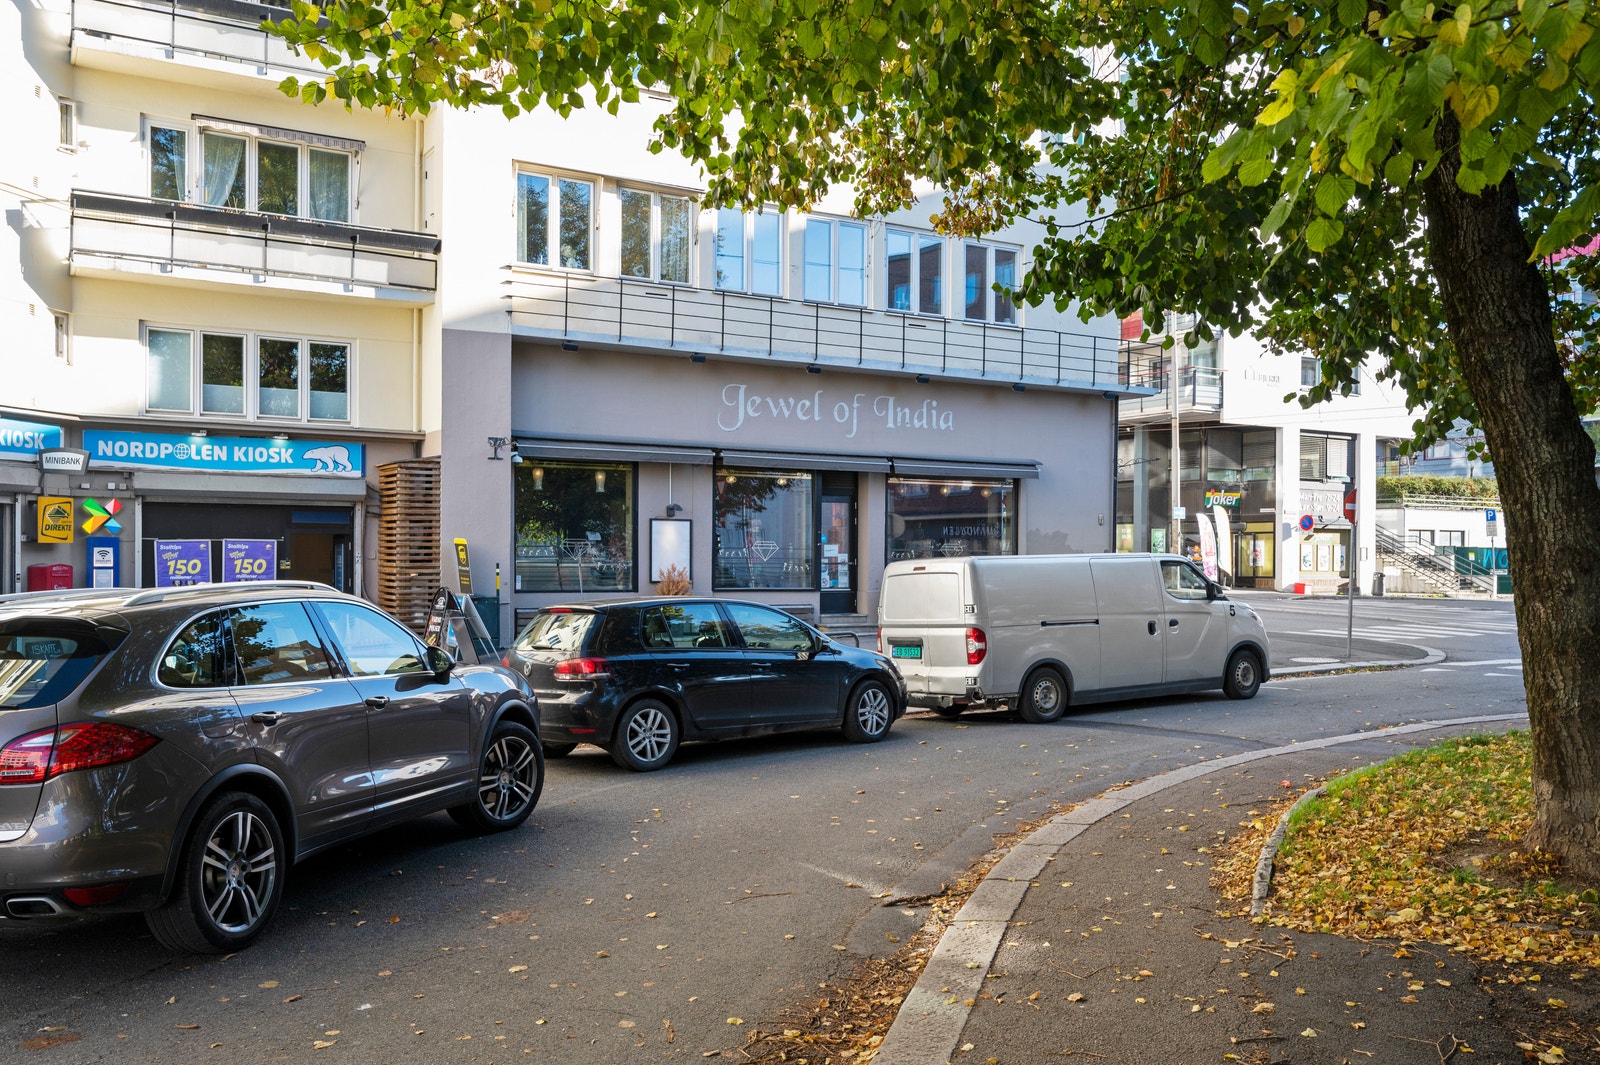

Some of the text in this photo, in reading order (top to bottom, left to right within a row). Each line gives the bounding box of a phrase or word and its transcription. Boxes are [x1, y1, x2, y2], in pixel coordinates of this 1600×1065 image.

[717, 383, 954, 438] Jewel of India
[44, 456, 81, 465] MINIBANK
[233, 446, 294, 464] KIOSK
[1206, 488, 1238, 508] joker
[1487, 510, 1493, 520] P
[44, 523, 72, 531] DIREKTE
[167, 558, 202, 575] 150
[234, 558, 267, 574] 150
[1229, 604, 1236, 617] 5
[896, 647, 920, 657] EB 91532
